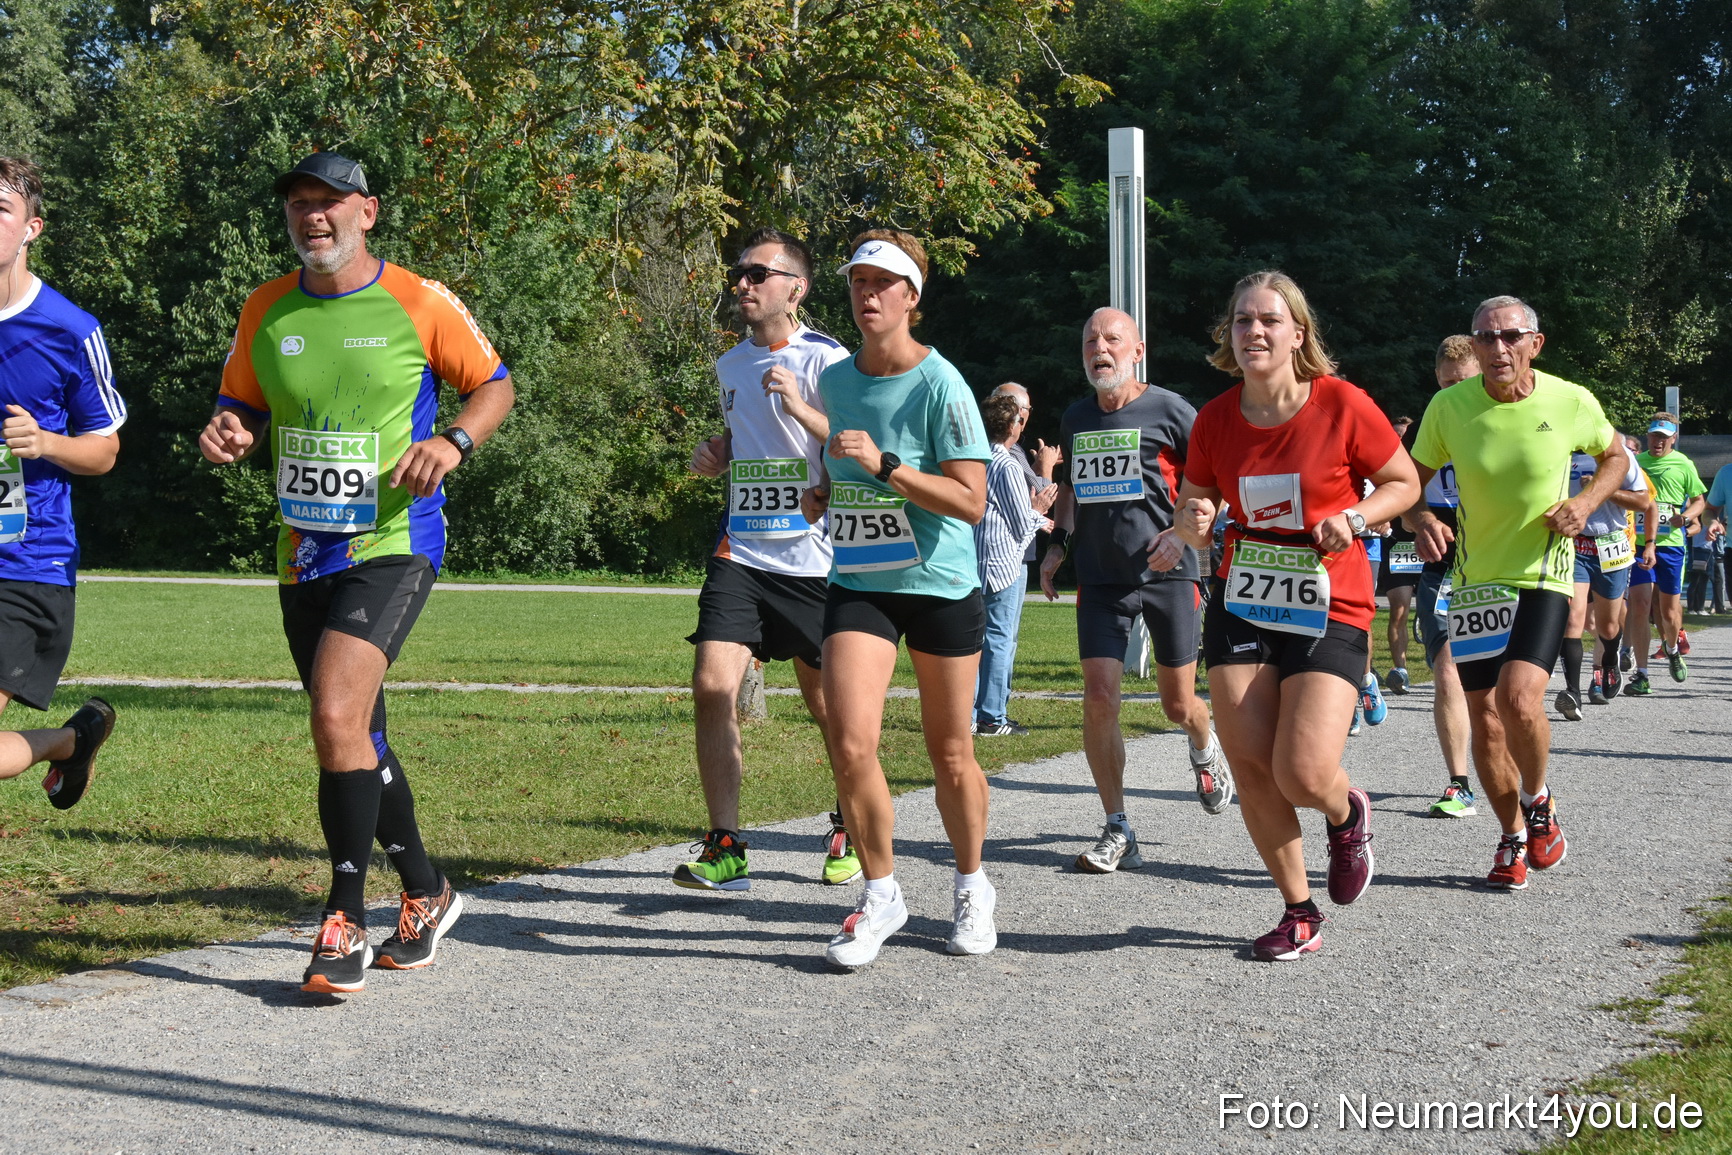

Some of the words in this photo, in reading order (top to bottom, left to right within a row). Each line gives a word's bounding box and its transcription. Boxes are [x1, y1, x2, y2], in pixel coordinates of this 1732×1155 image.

[344, 338, 387, 348] BOCK
[285, 432, 368, 460] BOCK
[1076, 433, 1132, 452] BOCK
[736, 461, 801, 480] BOCK
[1077, 455, 1130, 479] 2187
[286, 464, 364, 498] 2509
[1080, 483, 1131, 495] NORBERT
[738, 487, 799, 511] 2333
[833, 485, 896, 505] BOCK
[291, 504, 356, 521] MARKUS
[745, 518, 790, 529] TOBIAS
[834, 513, 901, 541] 2758
[1238, 545, 1319, 571] BOCK
[1237, 572, 1317, 605] 2716
[1450, 587, 1510, 607] BOCK
[1248, 606, 1292, 622] ANJA
[1453, 607, 1511, 637] 2800
